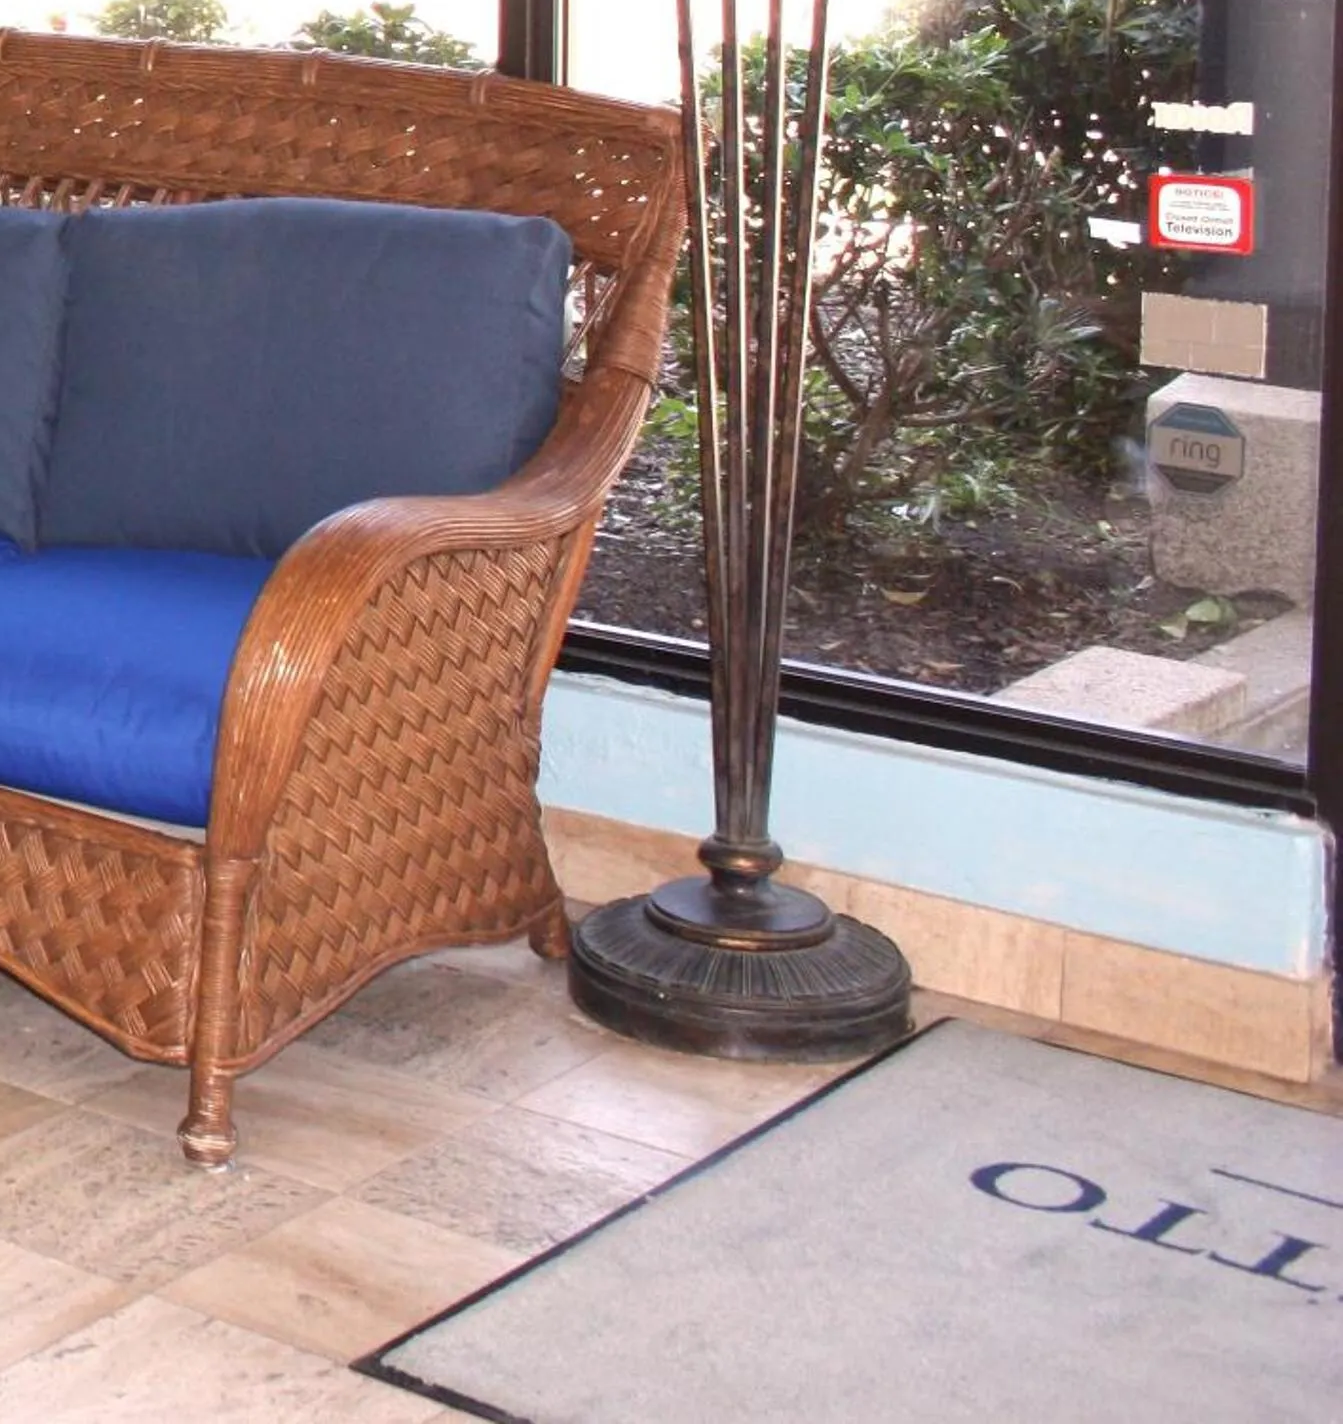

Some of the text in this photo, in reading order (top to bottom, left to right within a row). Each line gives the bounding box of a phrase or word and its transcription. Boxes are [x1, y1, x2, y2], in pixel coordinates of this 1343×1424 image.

[1165, 221, 1233, 237] Television
[1169, 436, 1221, 470] ring
[969, 1162, 1343, 1305] TTO
